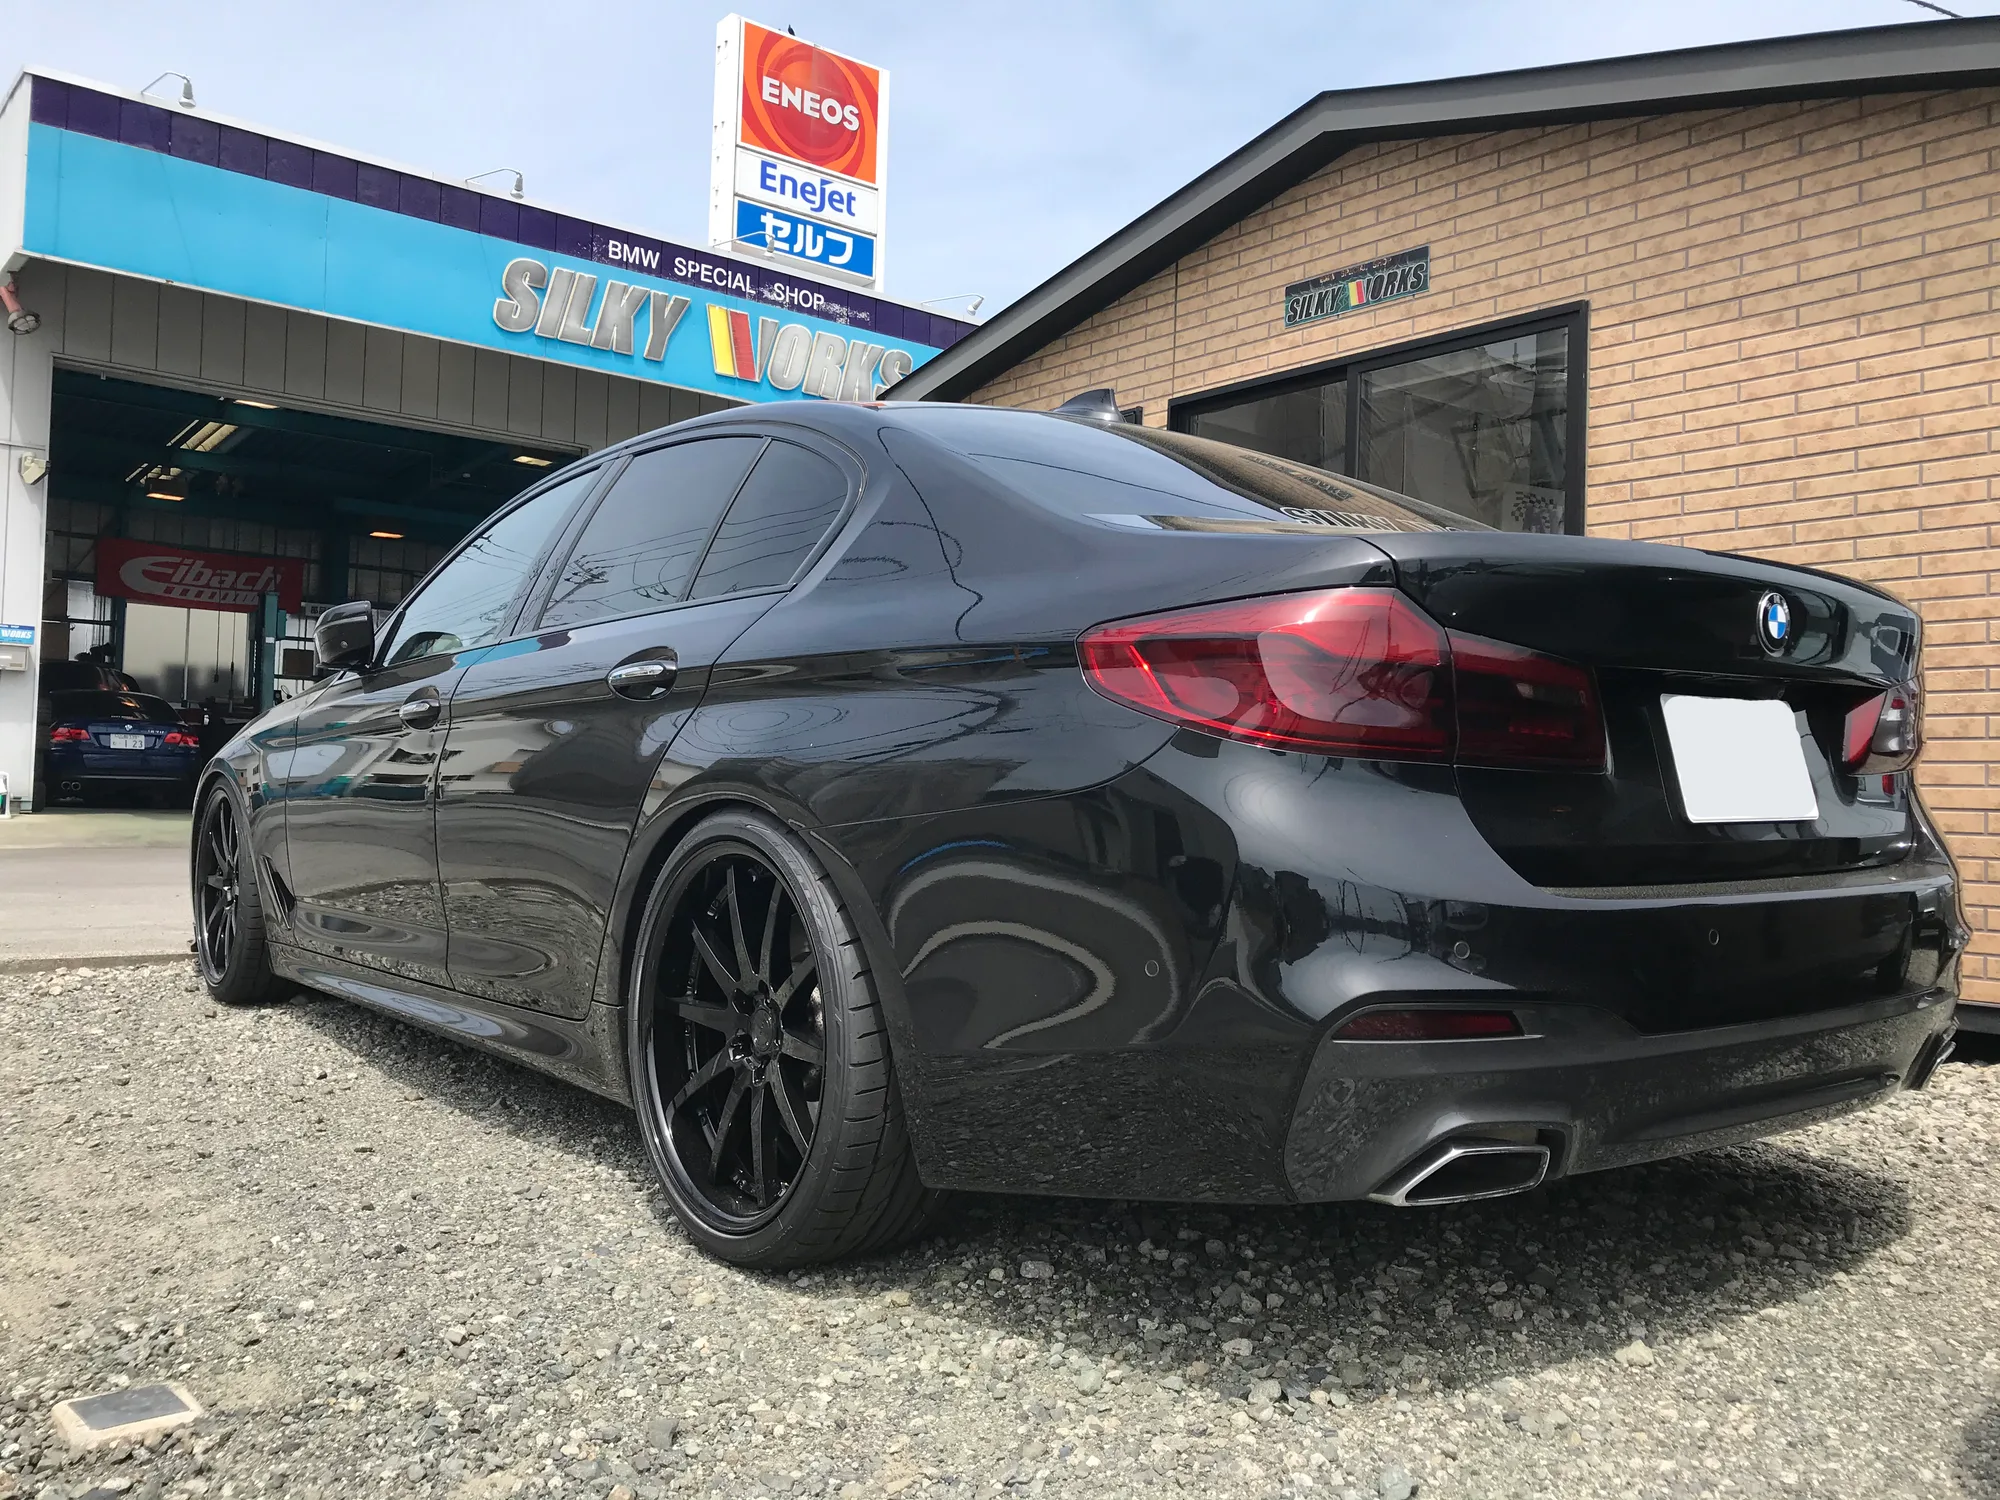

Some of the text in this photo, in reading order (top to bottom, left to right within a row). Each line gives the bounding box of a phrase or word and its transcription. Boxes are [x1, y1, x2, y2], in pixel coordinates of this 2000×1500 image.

[762, 75, 860, 132] ENEOS
[760, 159, 856, 217] Enejet
[760, 211, 853, 265] セルフ
[607, 239, 825, 311] BMW SPECIAL SHOP
[1285, 262, 1426, 324] SILKY WORKS
[492, 257, 692, 362] SILKY
[119, 556, 282, 599] Eibach
